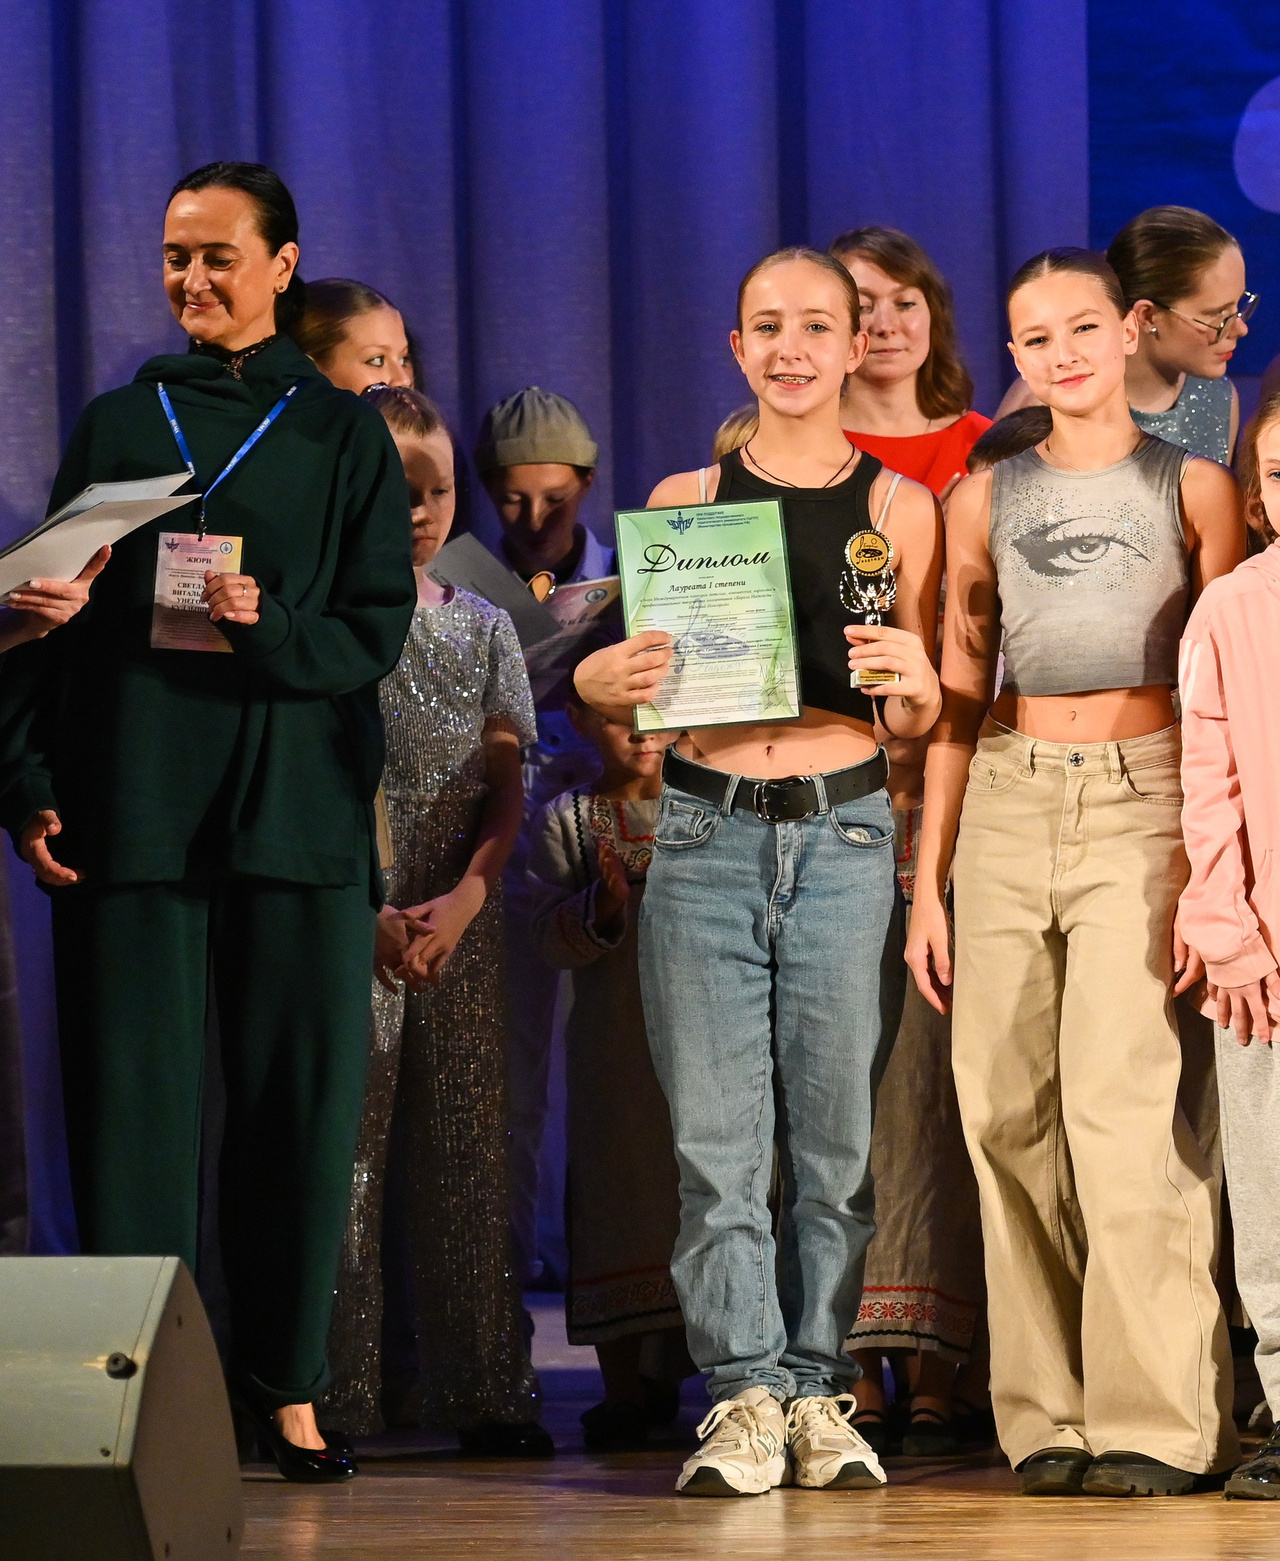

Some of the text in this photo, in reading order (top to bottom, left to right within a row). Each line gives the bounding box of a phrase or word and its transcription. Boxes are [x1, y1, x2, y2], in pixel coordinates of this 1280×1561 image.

[637, 544, 771, 575] Диплом
[668, 583, 706, 593] Лауреата
[715, 580, 746, 588] степени
